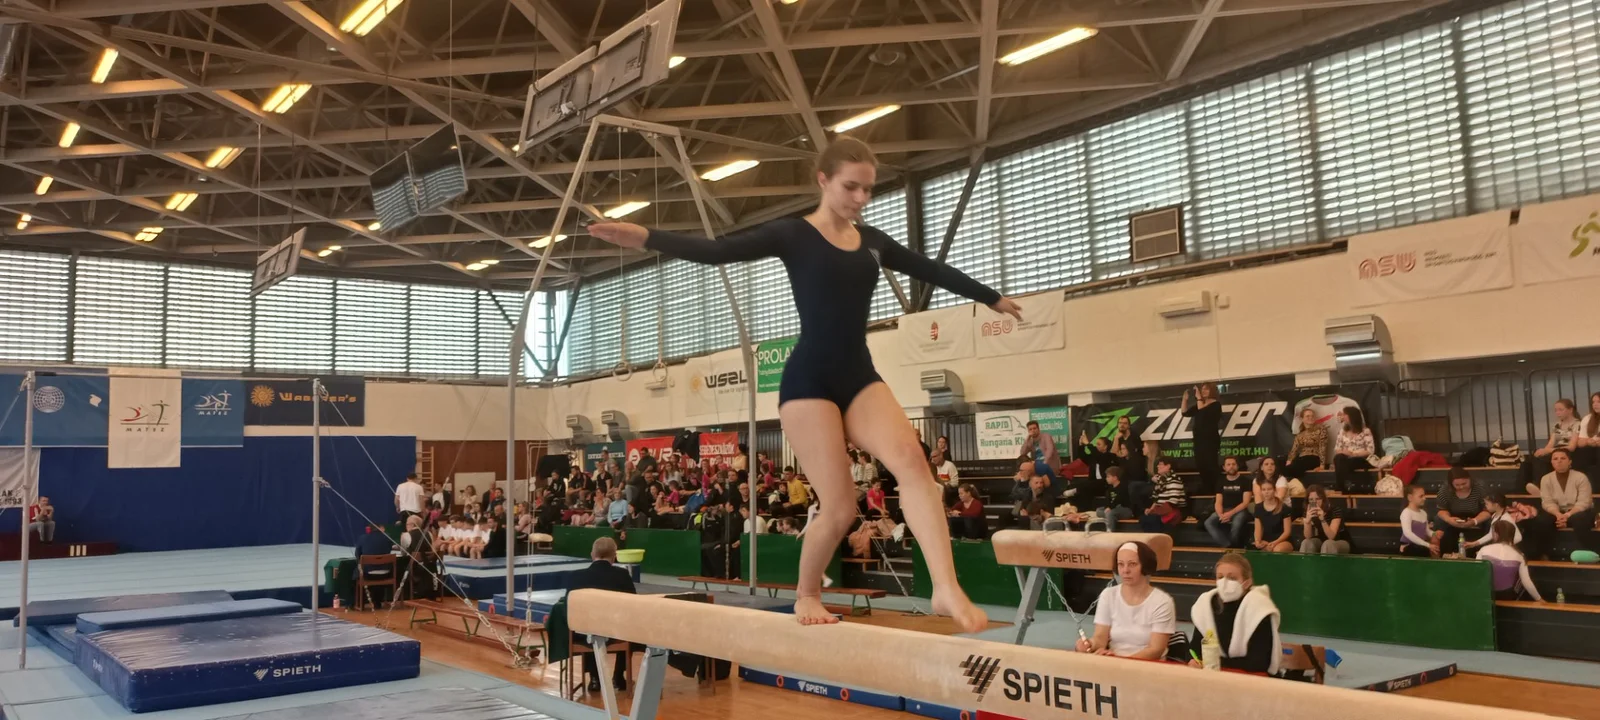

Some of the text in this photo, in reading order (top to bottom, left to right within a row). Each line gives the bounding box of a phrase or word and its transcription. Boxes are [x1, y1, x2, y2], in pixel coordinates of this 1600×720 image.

[758, 346, 795, 365] PROLA
[1056, 552, 1091, 564] SPIETH
[272, 664, 322, 678] SPIETH
[806, 683, 828, 695] SPIETH
[1003, 668, 1118, 719] SPIETH
